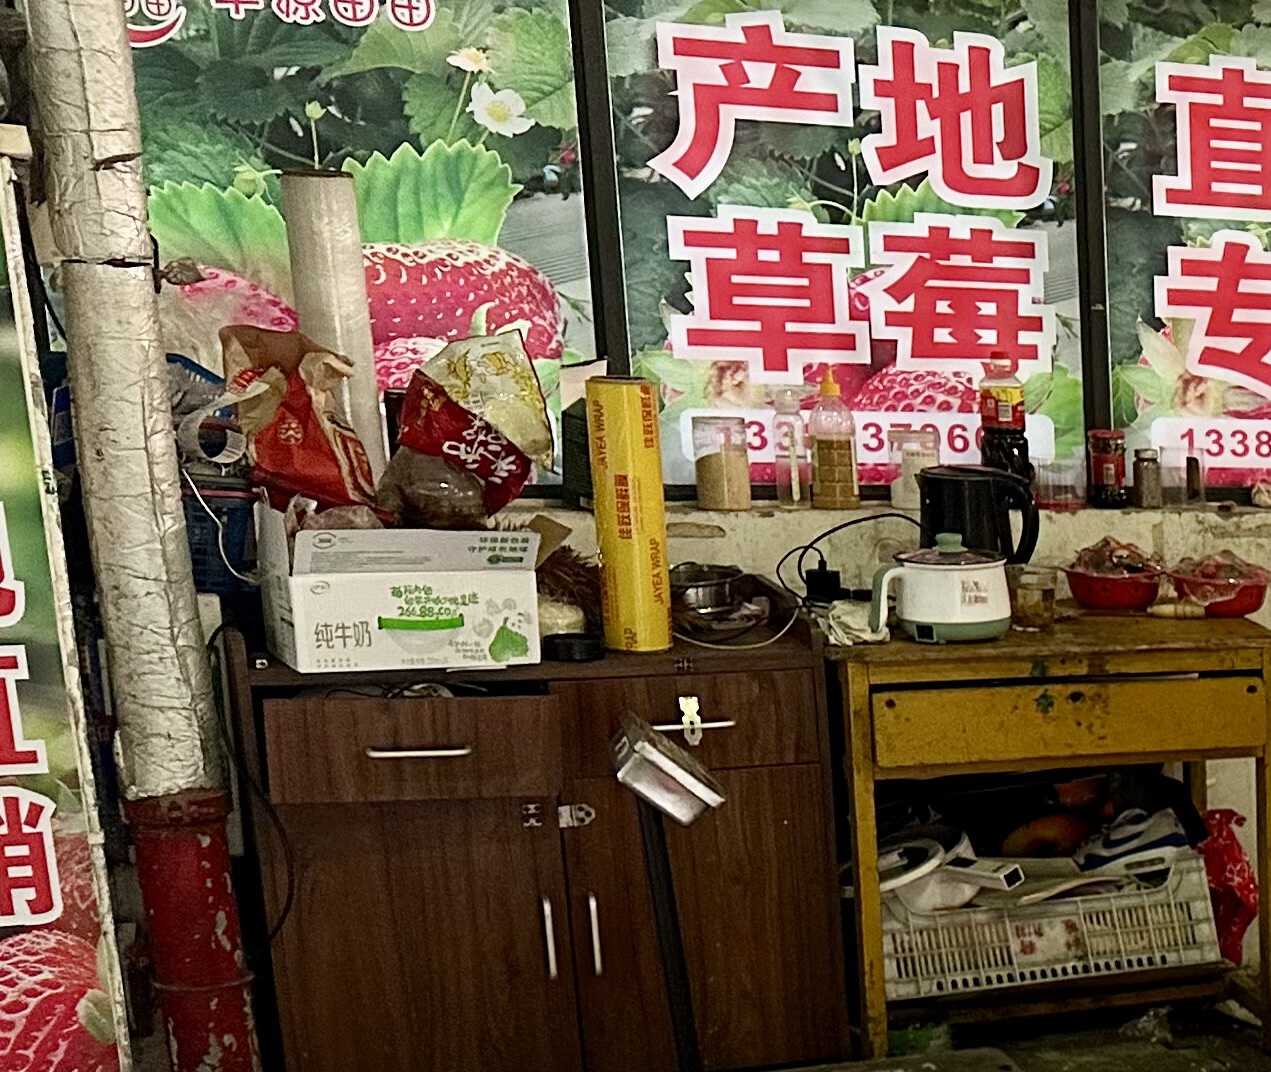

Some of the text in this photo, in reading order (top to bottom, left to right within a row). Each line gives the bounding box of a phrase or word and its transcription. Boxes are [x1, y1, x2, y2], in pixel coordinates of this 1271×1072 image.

[662, 18, 1047, 203] 产地
[675, 212, 1049, 378] 草莓
[649, 538, 662, 569] WRAP
[314, 621, 372, 649] 纯牛奶
